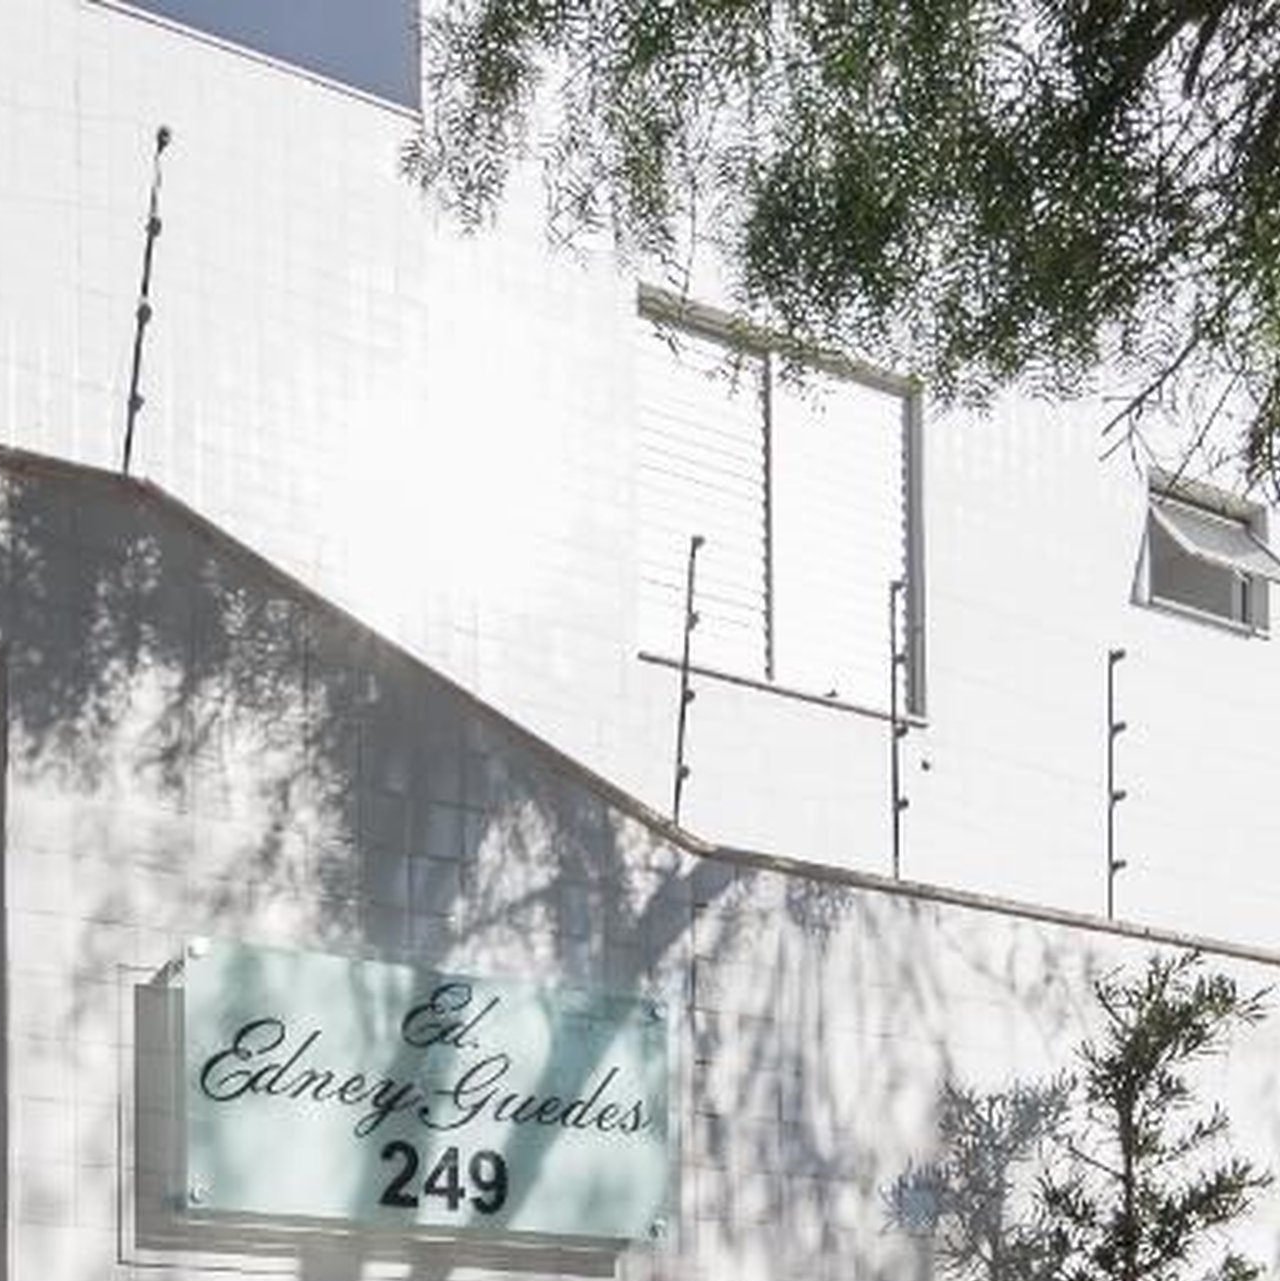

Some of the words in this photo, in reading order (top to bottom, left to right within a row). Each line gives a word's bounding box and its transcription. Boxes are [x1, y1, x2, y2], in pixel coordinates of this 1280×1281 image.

[401, 983, 500, 1050] Ed.
[198, 1018, 420, 1138] Edney
[419, 1053, 652, 1133] Guedes
[377, 1140, 510, 1215] 249
